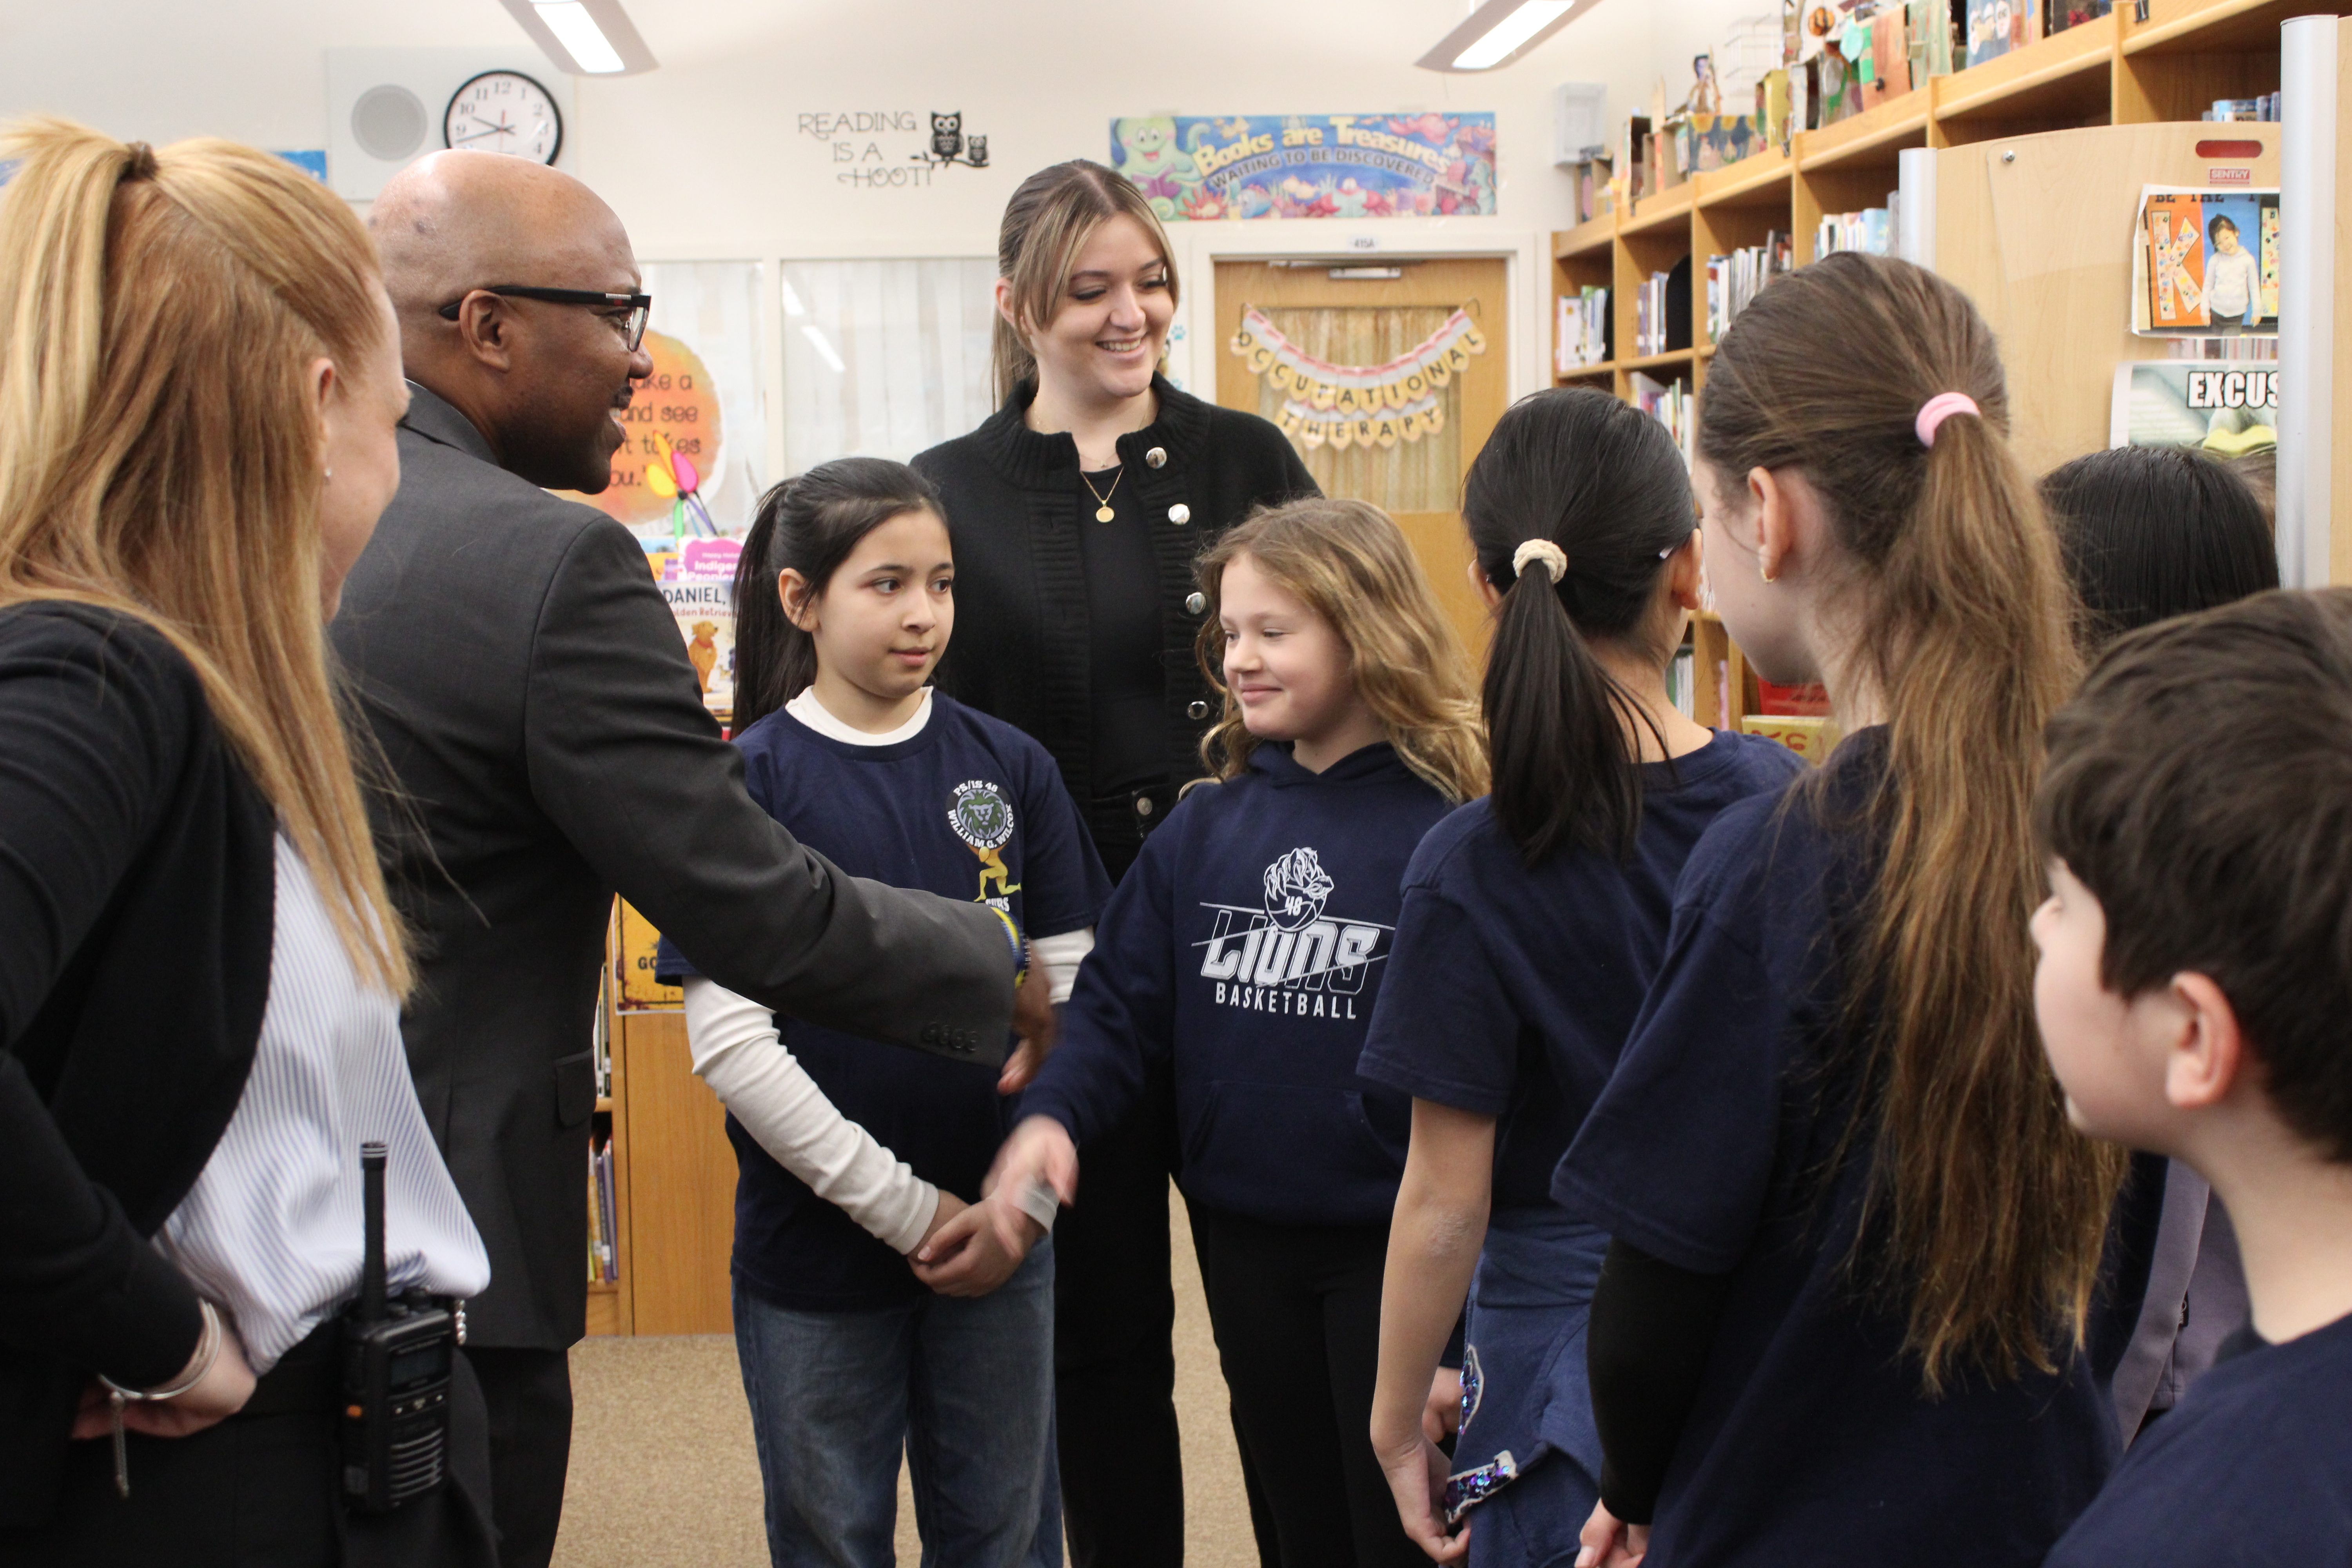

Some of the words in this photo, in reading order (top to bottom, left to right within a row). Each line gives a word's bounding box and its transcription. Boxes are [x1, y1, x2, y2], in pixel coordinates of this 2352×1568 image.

[476, 87, 488, 100] 11
[494, 81, 511, 94] 12
[521, 87, 526, 100] 1
[460, 103, 475, 115] 10
[533, 103, 543, 116] 2
[456, 124, 466, 136] 9
[798, 111, 917, 140] READING
[833, 142, 854, 162] IS
[862, 142, 883, 162] A
[1192, 133, 1274, 176] Books
[1282, 127, 1323, 147] are
[1329, 116, 1451, 174] Treasures
[1212, 155, 1280, 188] WAITING
[1285, 150, 1305, 164] TO
[1311, 149, 1330, 163] BE
[1336, 149, 1435, 184] DISCOVERED
[2211, 169, 2249, 179] SENTRY
[1238, 332, 1478, 404] OCCUPATIONAL
[630, 374, 671, 390] ake
[679, 374, 692, 390] a
[661, 406, 698, 423] see
[1283, 408, 1435, 438] THERAPY
[663, 587, 726, 605] DANIEL,
[673, 608, 697, 616] olden
[953, 780, 983, 797] PS/IS
[985, 782, 998, 792] 48
[947, 809, 985, 848] WILLIAM
[986, 840, 998, 849] G.
[995, 804, 1014, 845] WILCOX
[1285, 896, 1303, 916] 48
[1201, 909, 1380, 995] LIONS
[1216, 982, 1356, 1019] BASKETBALL
